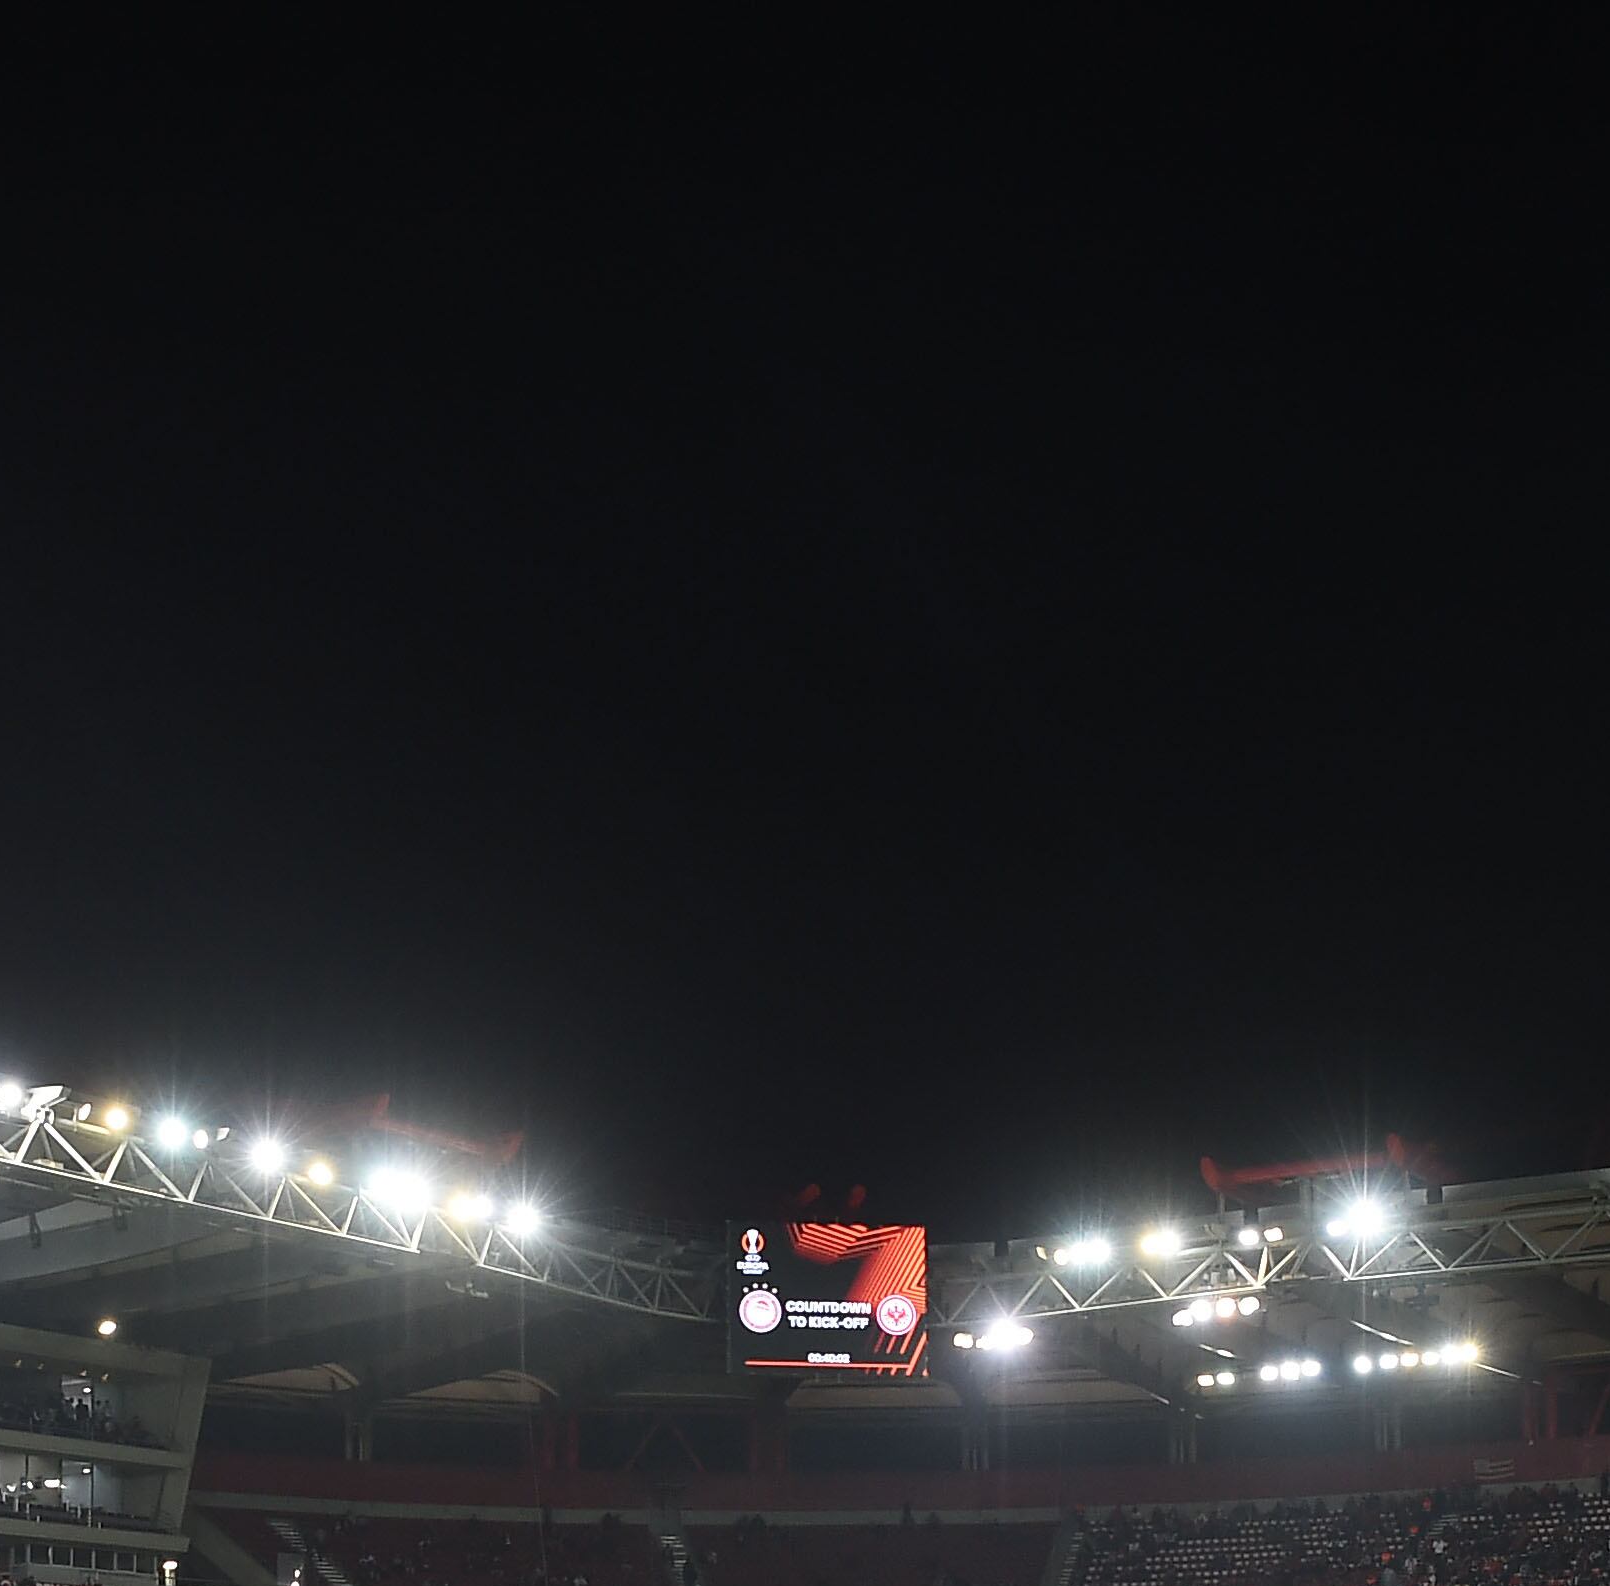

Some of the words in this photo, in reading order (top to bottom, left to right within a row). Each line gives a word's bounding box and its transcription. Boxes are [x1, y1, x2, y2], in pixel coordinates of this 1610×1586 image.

[785, 1300, 872, 1315] COUNTDOWN
[788, 1315, 807, 1328] TO
[809, 1316, 869, 1330] KICK-OFF
